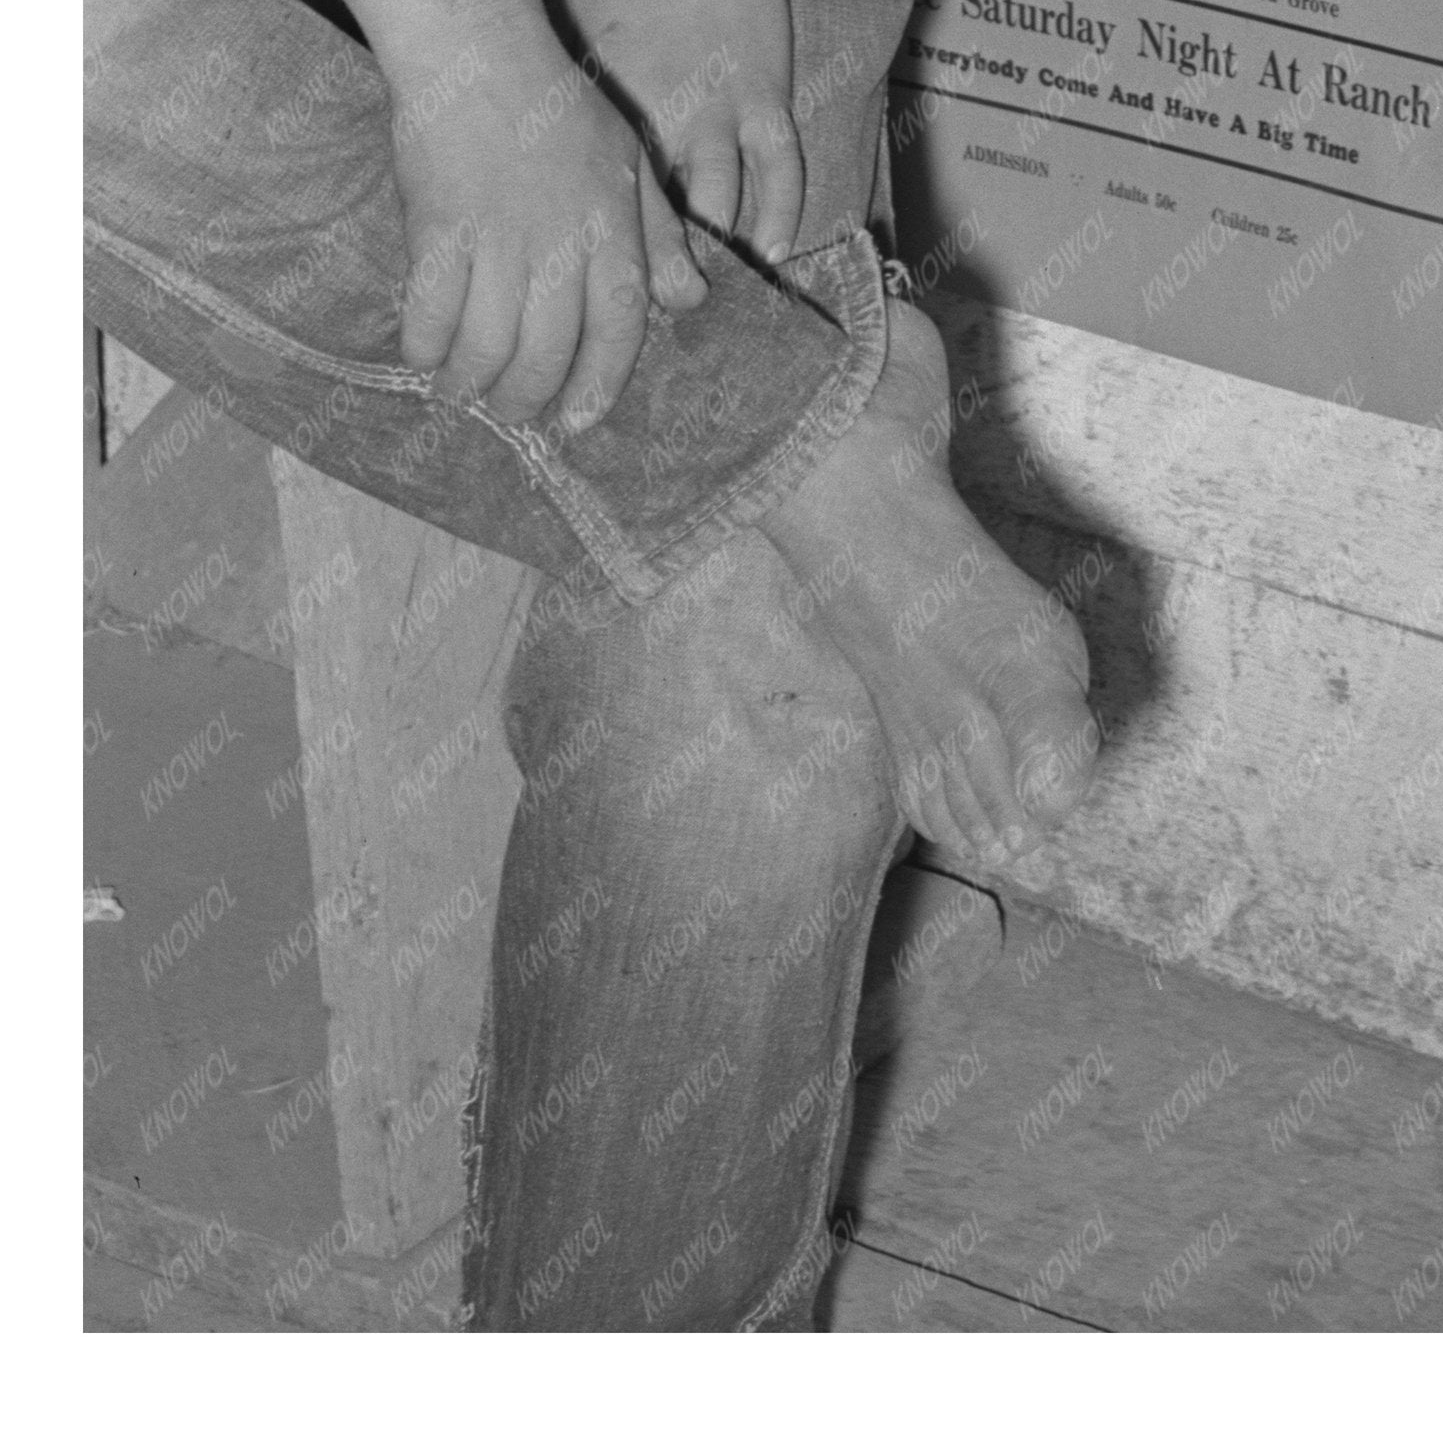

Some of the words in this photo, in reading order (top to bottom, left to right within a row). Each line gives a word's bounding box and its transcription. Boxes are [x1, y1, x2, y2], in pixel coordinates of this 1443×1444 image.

[1136, 17, 1238, 82] Night
[1257, 51, 1302, 94] At
[1321, 62, 1432, 129] Ranch
